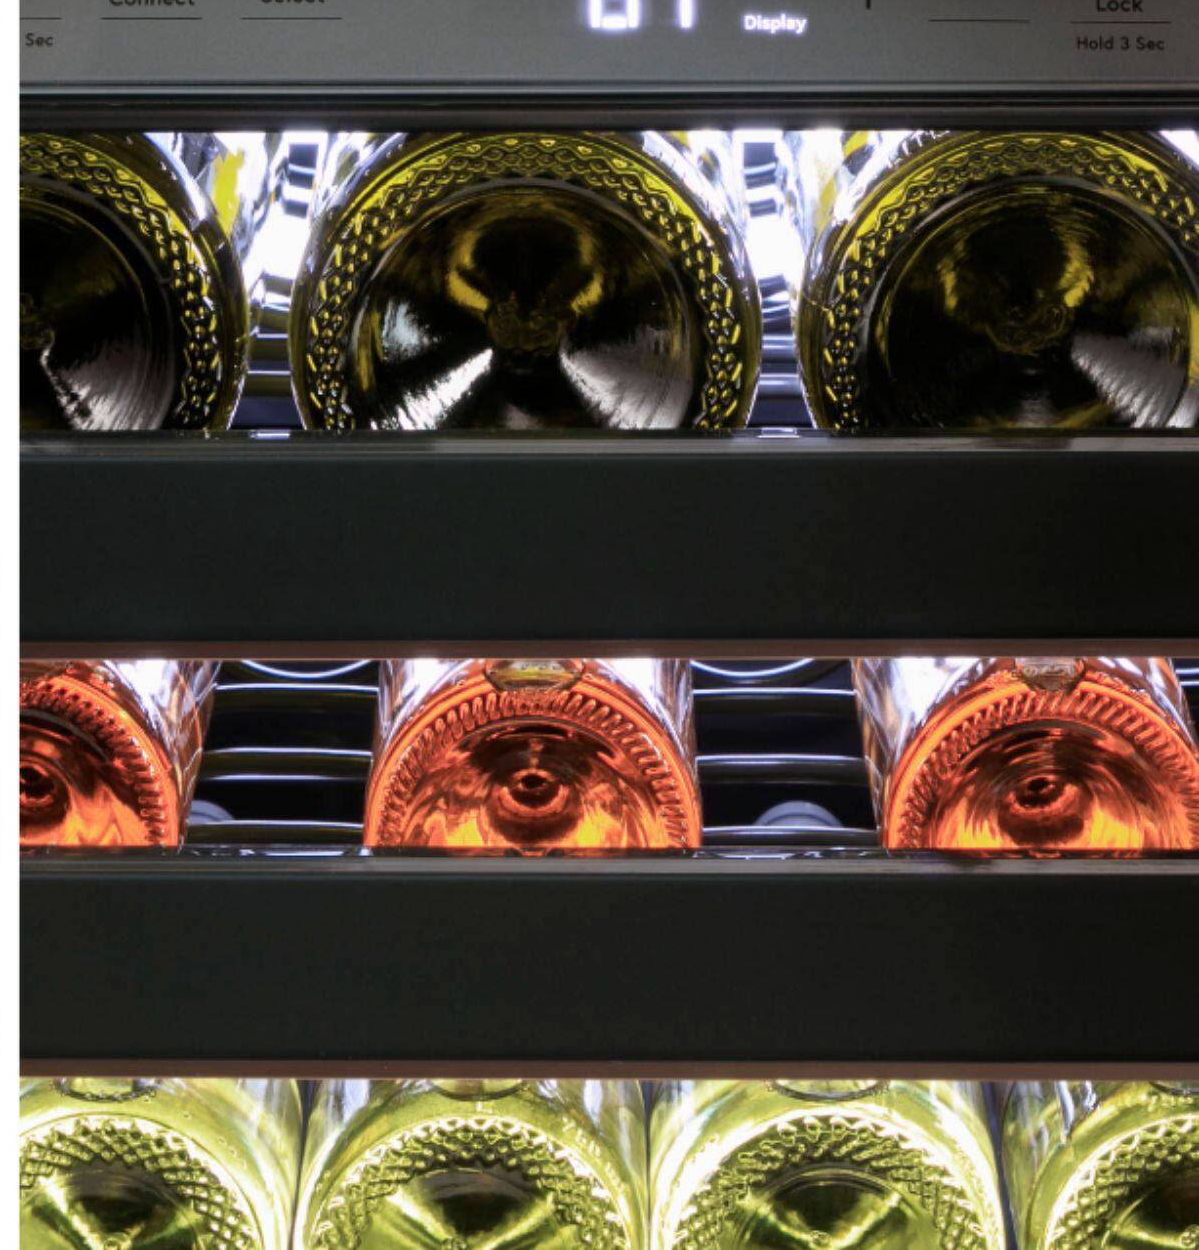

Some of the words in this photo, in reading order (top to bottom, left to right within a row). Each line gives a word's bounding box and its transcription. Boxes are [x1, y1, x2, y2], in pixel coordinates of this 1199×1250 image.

[743, 14, 809, 34] Display
[25, 33, 54, 47] Sec
[1076, 36, 1114, 51] Hold
[1120, 36, 1130, 51] 3
[1136, 36, 1166, 51] Sec
